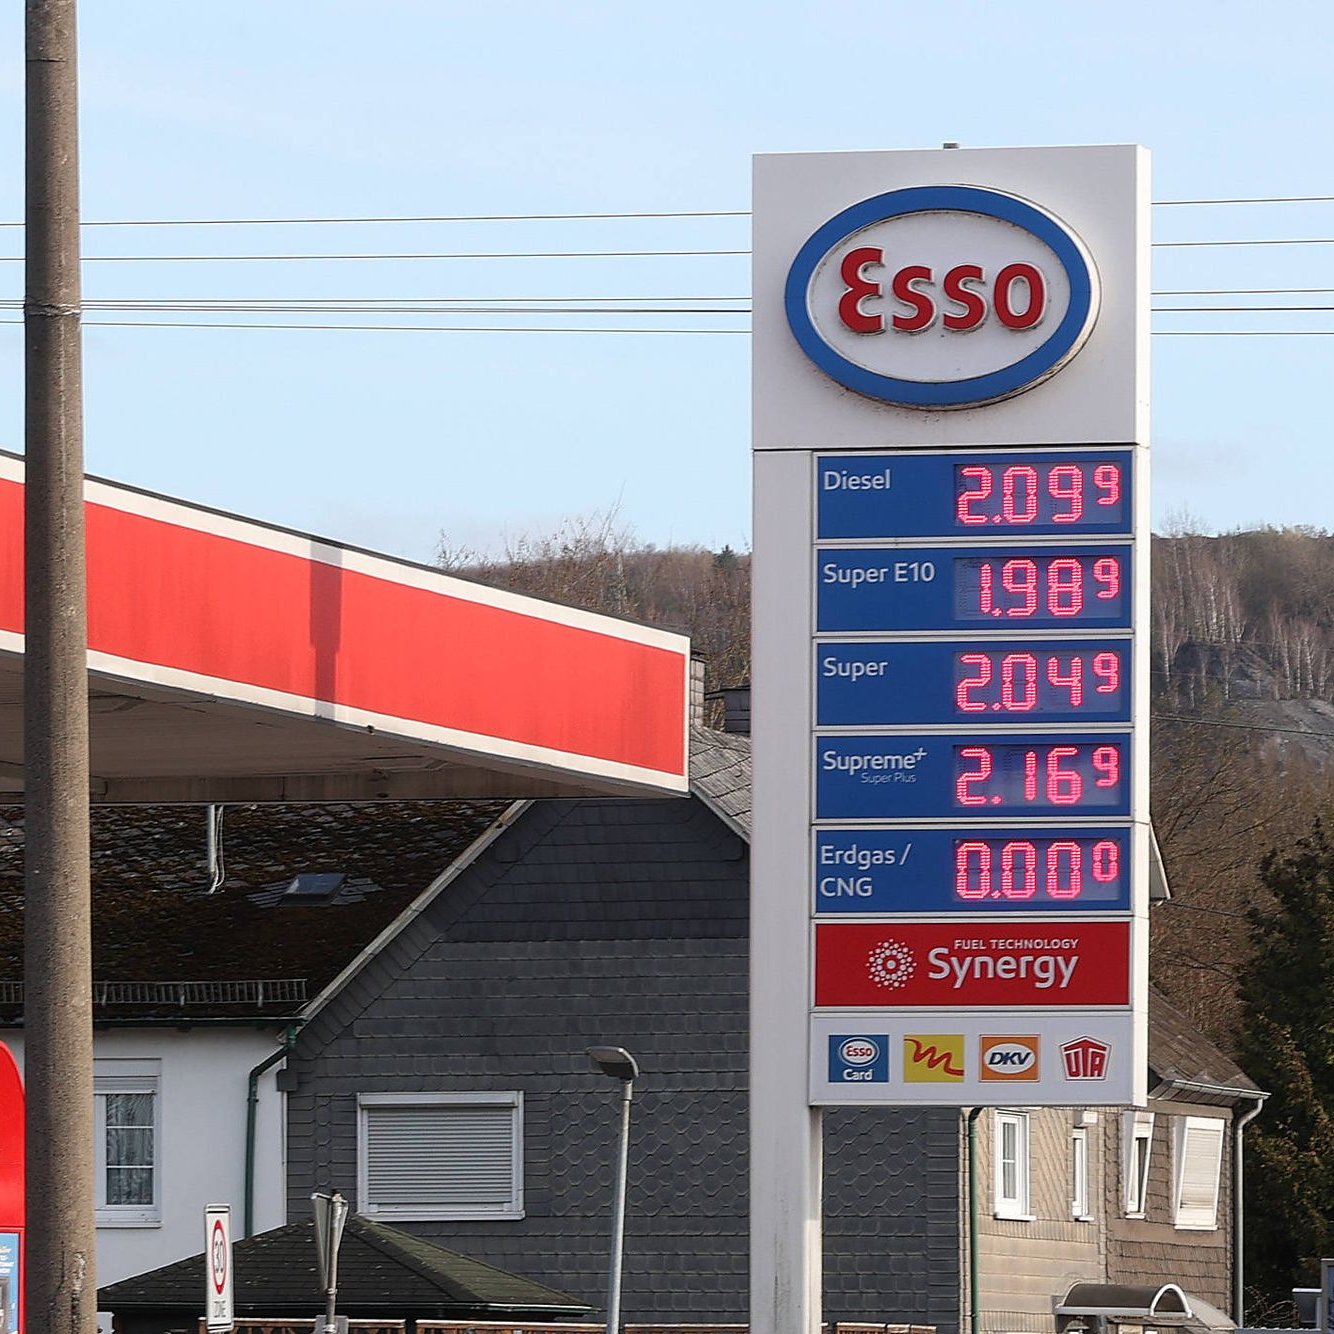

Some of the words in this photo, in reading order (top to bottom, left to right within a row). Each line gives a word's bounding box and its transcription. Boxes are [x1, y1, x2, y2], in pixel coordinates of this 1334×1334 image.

[838, 247, 1046, 333] Esso
[823, 469, 891, 490] Diesel
[823, 563, 886, 586] Super
[894, 562, 936, 583] E10
[822, 657, 888, 681] Super
[860, 774, 891, 785] Super
[894, 772, 917, 783] Plus
[821, 846, 896, 870] Erdgas
[820, 876, 873, 897] CNG
[954, 939, 987, 950] FUEL
[989, 938, 1080, 950] TECHNOLOGY
[927, 947, 1079, 989] Synergy
[845, 1043, 874, 1059] Esso
[987, 1050, 1032, 1067] DKV
[1064, 1048, 1107, 1079] UTA
[843, 1068, 873, 1081] Card
